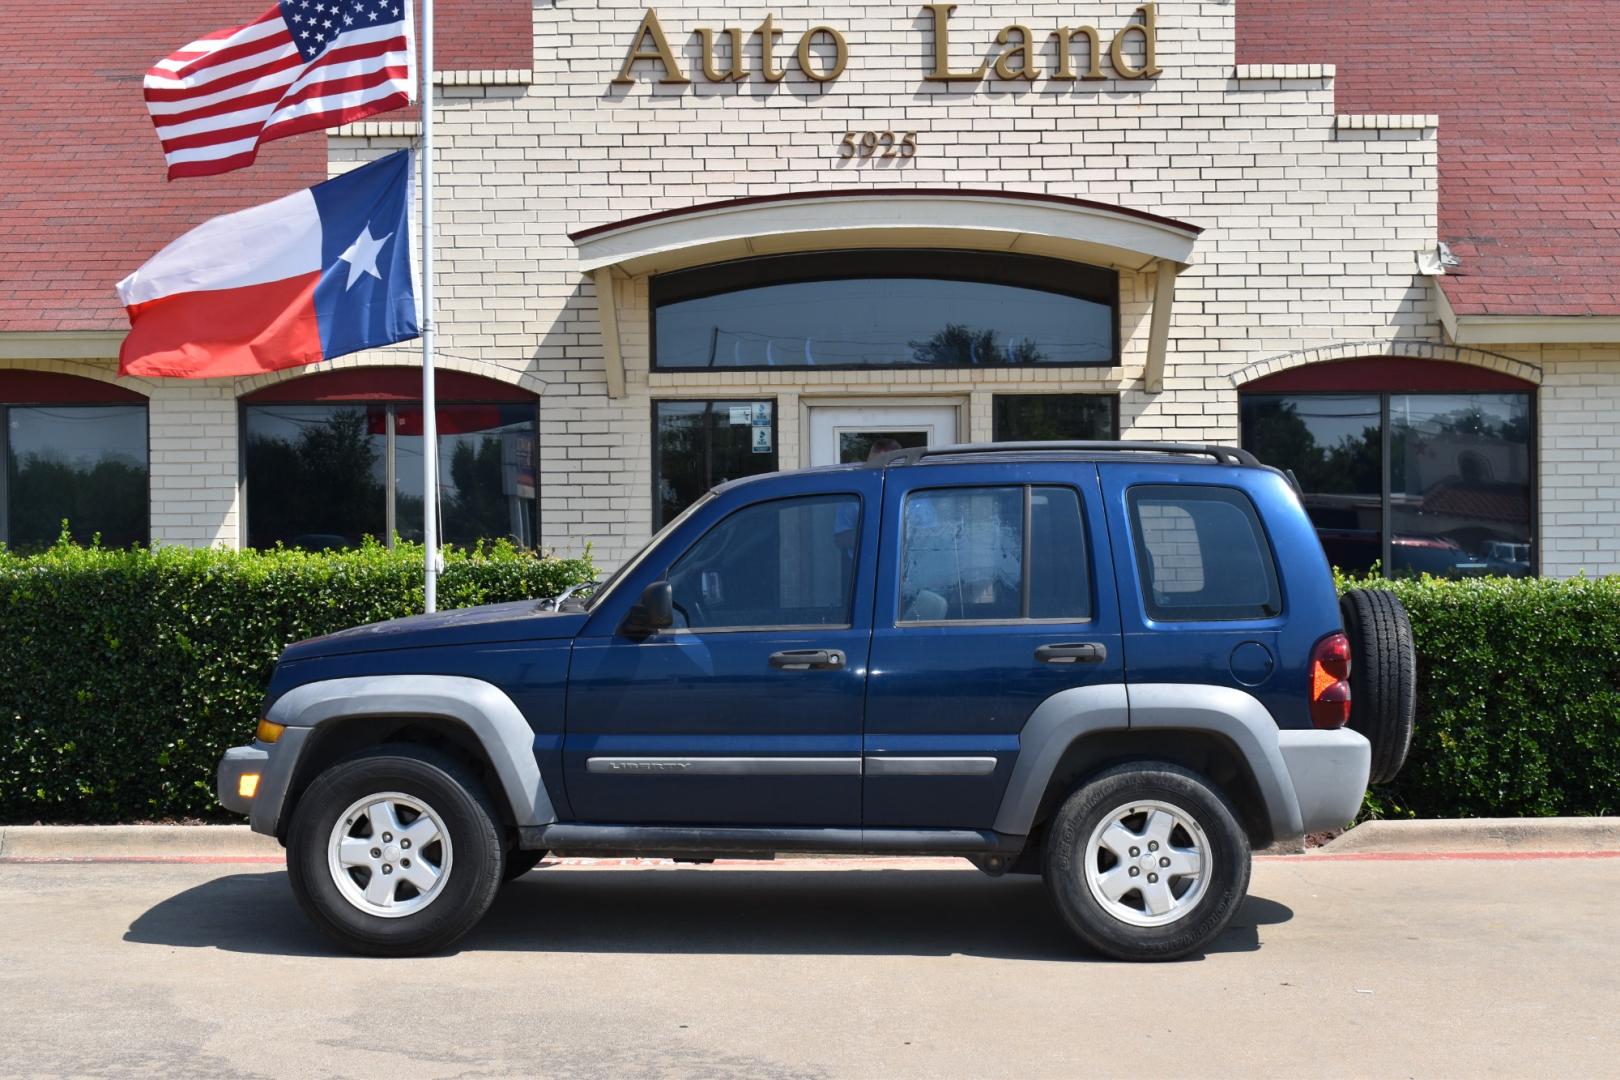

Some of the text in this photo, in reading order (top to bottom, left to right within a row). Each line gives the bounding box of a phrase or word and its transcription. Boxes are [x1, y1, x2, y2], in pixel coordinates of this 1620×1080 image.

[611, 3, 1163, 84] Auto Land
[841, 131, 916, 159] 5925
